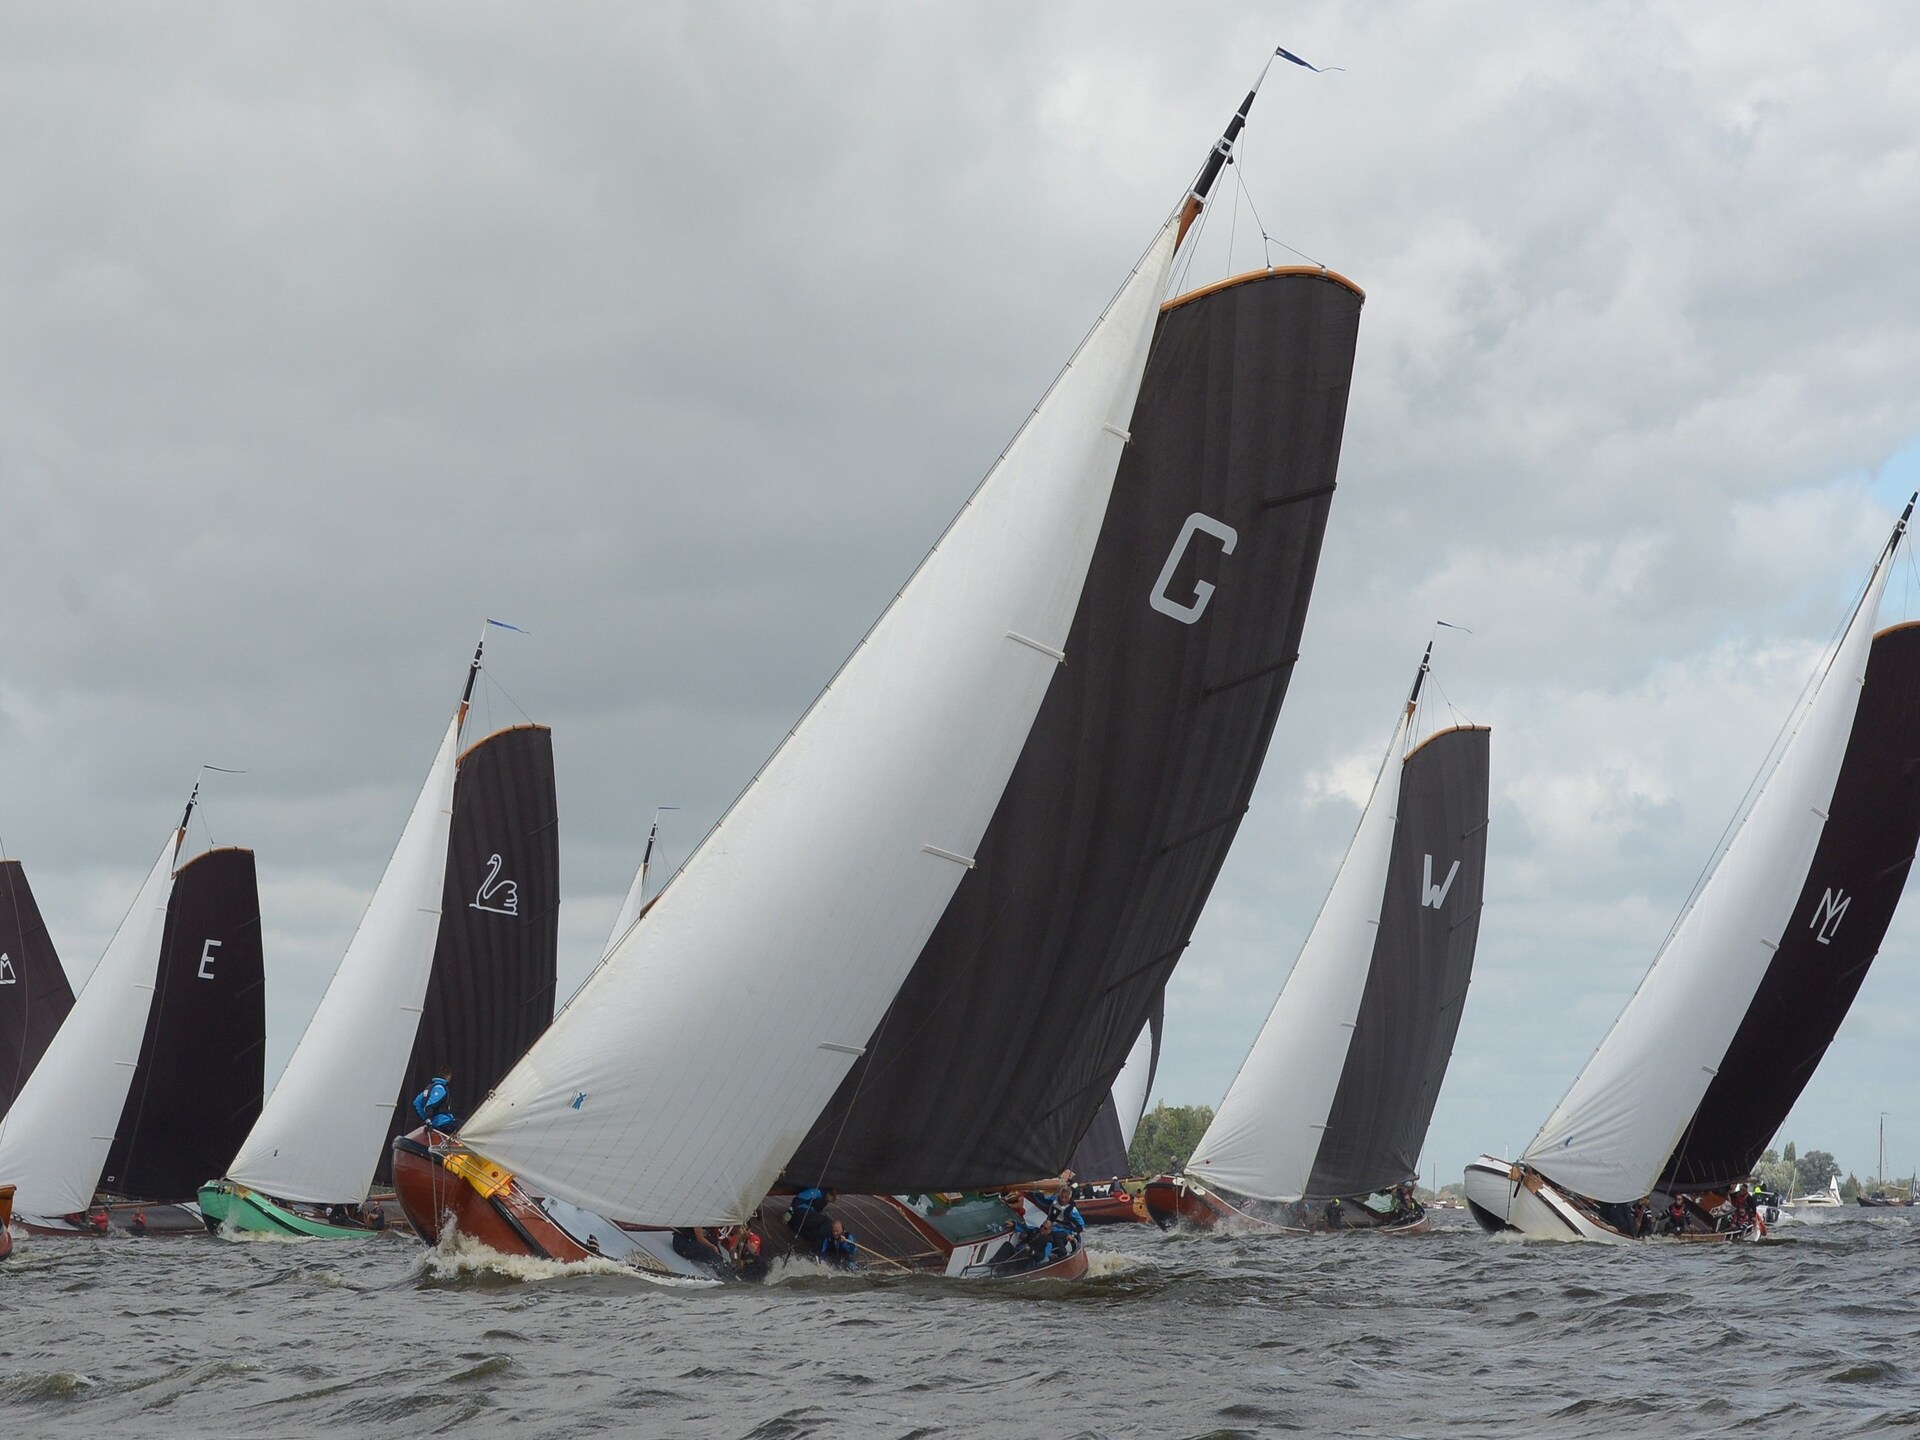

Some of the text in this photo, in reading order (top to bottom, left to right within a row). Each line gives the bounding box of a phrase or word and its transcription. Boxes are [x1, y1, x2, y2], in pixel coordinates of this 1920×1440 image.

[1149, 512, 1238, 625] G
[1421, 853, 1461, 910] W
[197, 938, 222, 980] E
